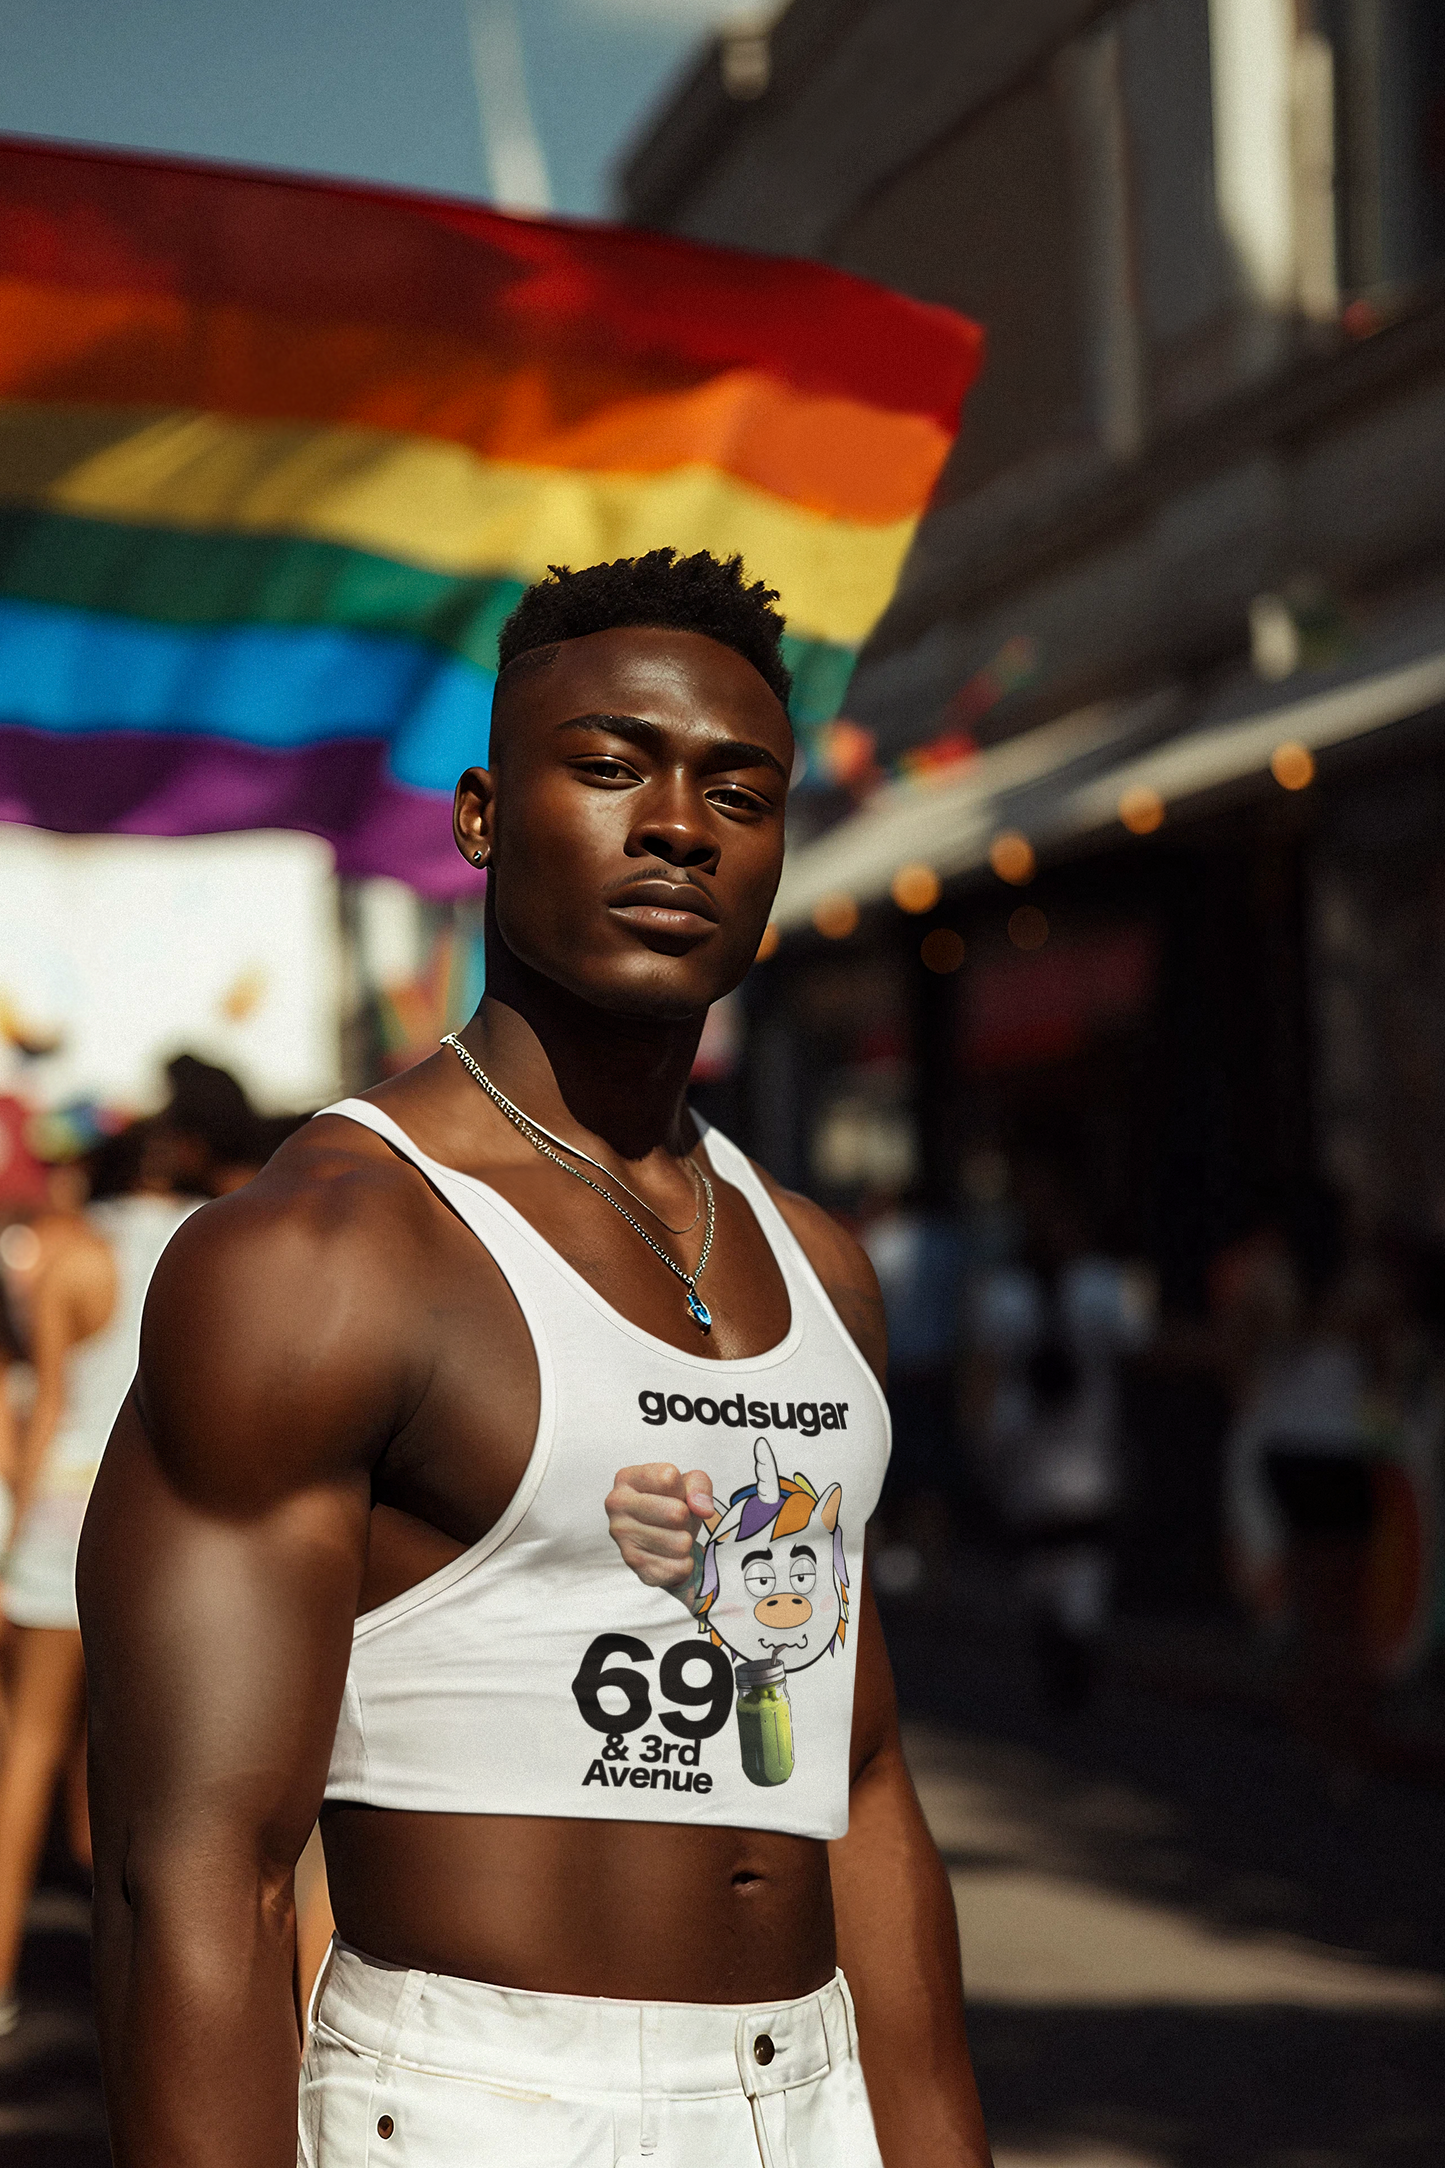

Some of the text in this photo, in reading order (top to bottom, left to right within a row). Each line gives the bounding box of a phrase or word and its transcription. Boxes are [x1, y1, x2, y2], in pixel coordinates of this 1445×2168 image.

[637, 1389, 849, 1437] goodsugar
[571, 1632, 734, 1740] 69
[601, 1732, 701, 1767] & 3rd
[581, 1758, 714, 1795] Avenue
